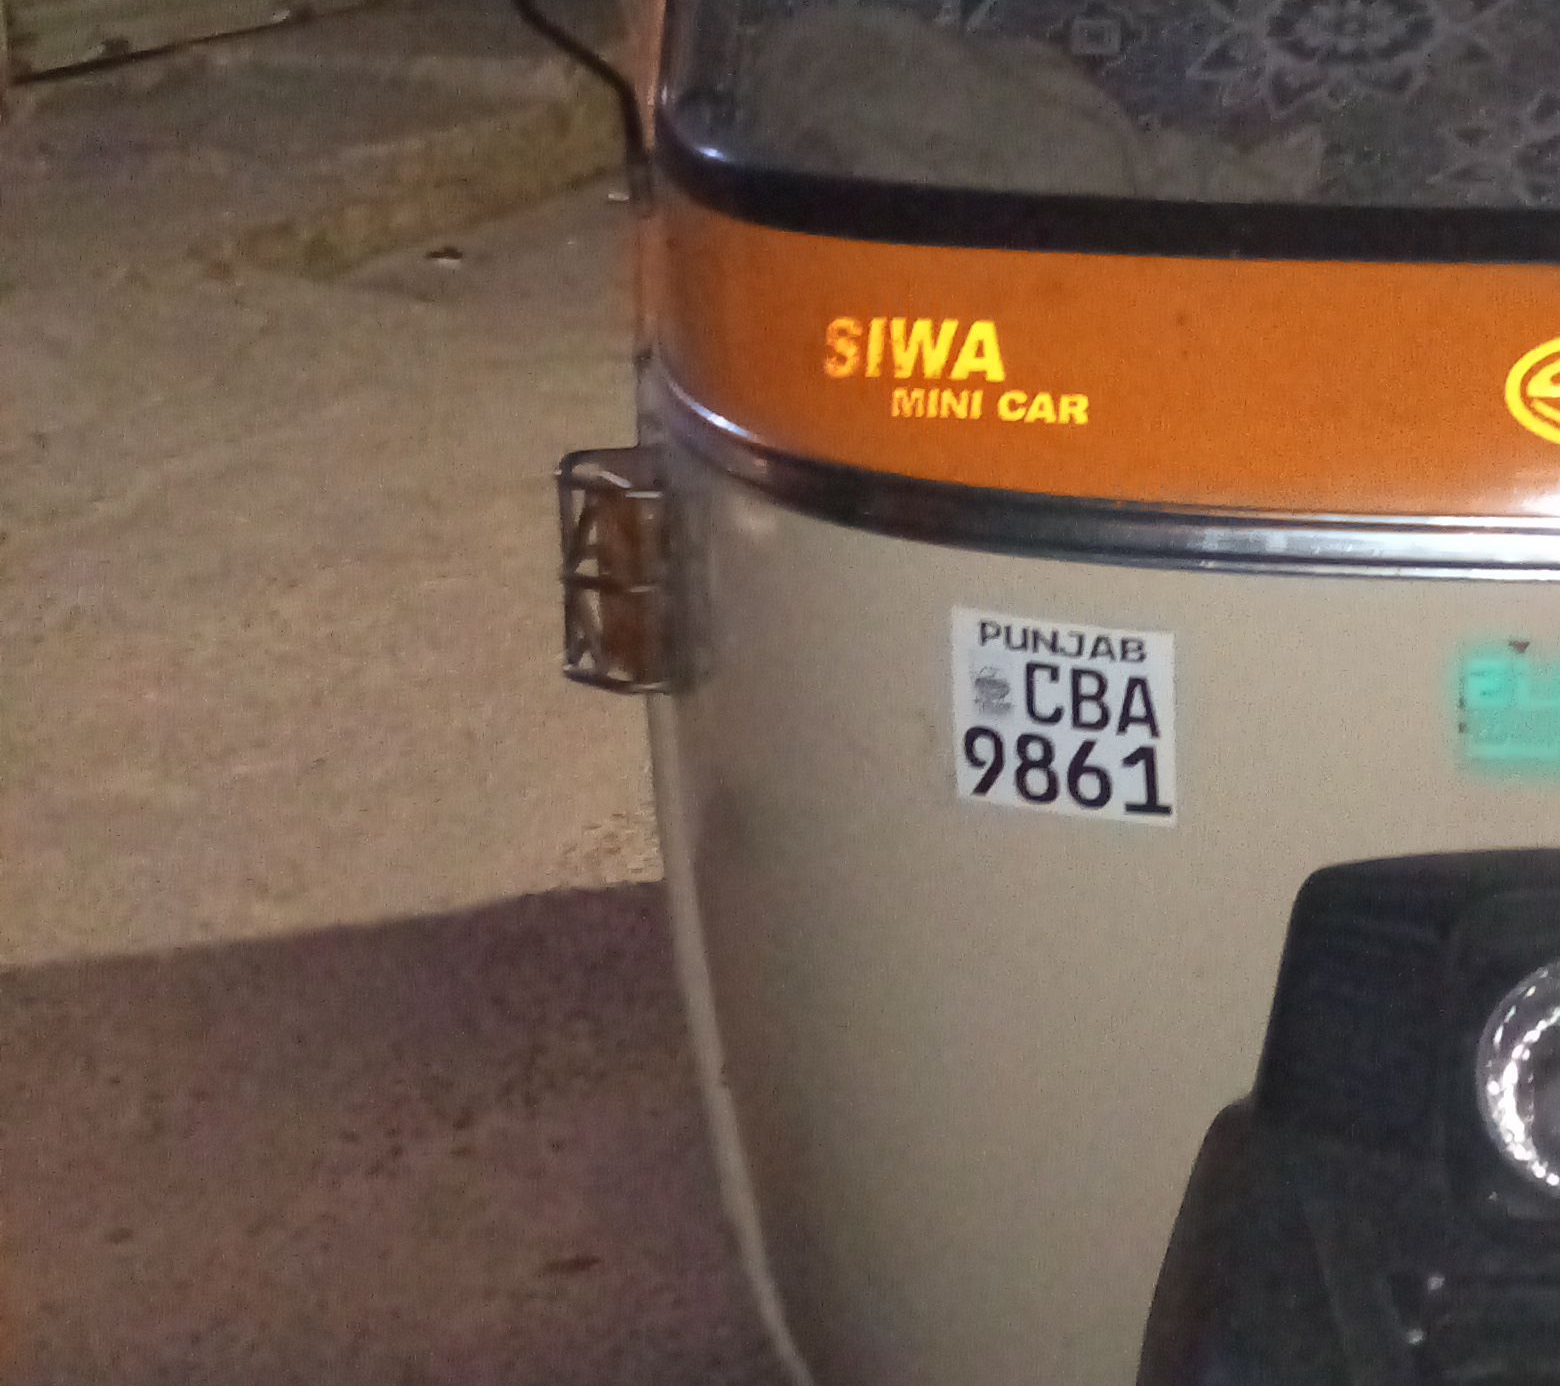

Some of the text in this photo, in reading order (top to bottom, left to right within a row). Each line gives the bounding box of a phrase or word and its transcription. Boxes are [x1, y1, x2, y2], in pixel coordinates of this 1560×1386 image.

[824, 316, 1006, 383] SIWA
[891, 387, 1090, 425] MINI CAR
[978, 618, 1148, 663] PUNJAB
[1024, 660, 1160, 739] CBA
[963, 724, 1173, 816] 9861
